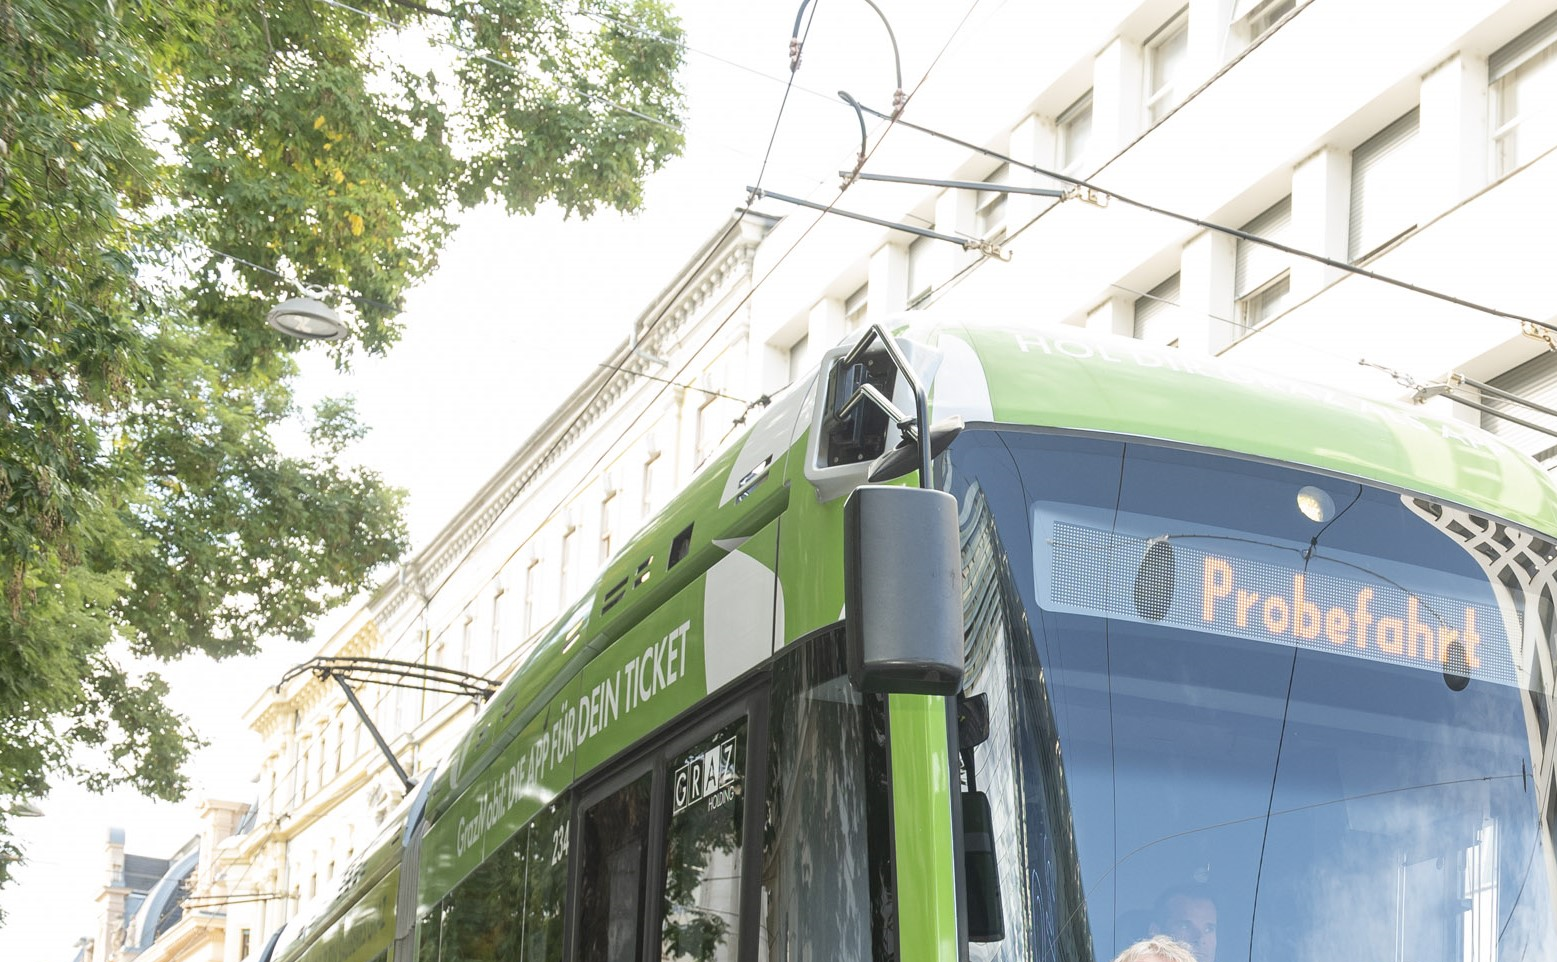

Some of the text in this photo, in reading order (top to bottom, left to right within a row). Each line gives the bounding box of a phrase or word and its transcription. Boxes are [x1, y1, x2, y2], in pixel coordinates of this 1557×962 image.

[1202, 556, 1481, 668] Probefahrt
[507, 757, 526, 812] DIE
[526, 732, 550, 788] APP
[550, 700, 575, 770] FÜR
[577, 670, 621, 746] DEIN
[625, 620, 691, 713] TICKET
[676, 744, 734, 806] GRAZ
[708, 785, 735, 812] HOLDING
[551, 821, 570, 866] 234
